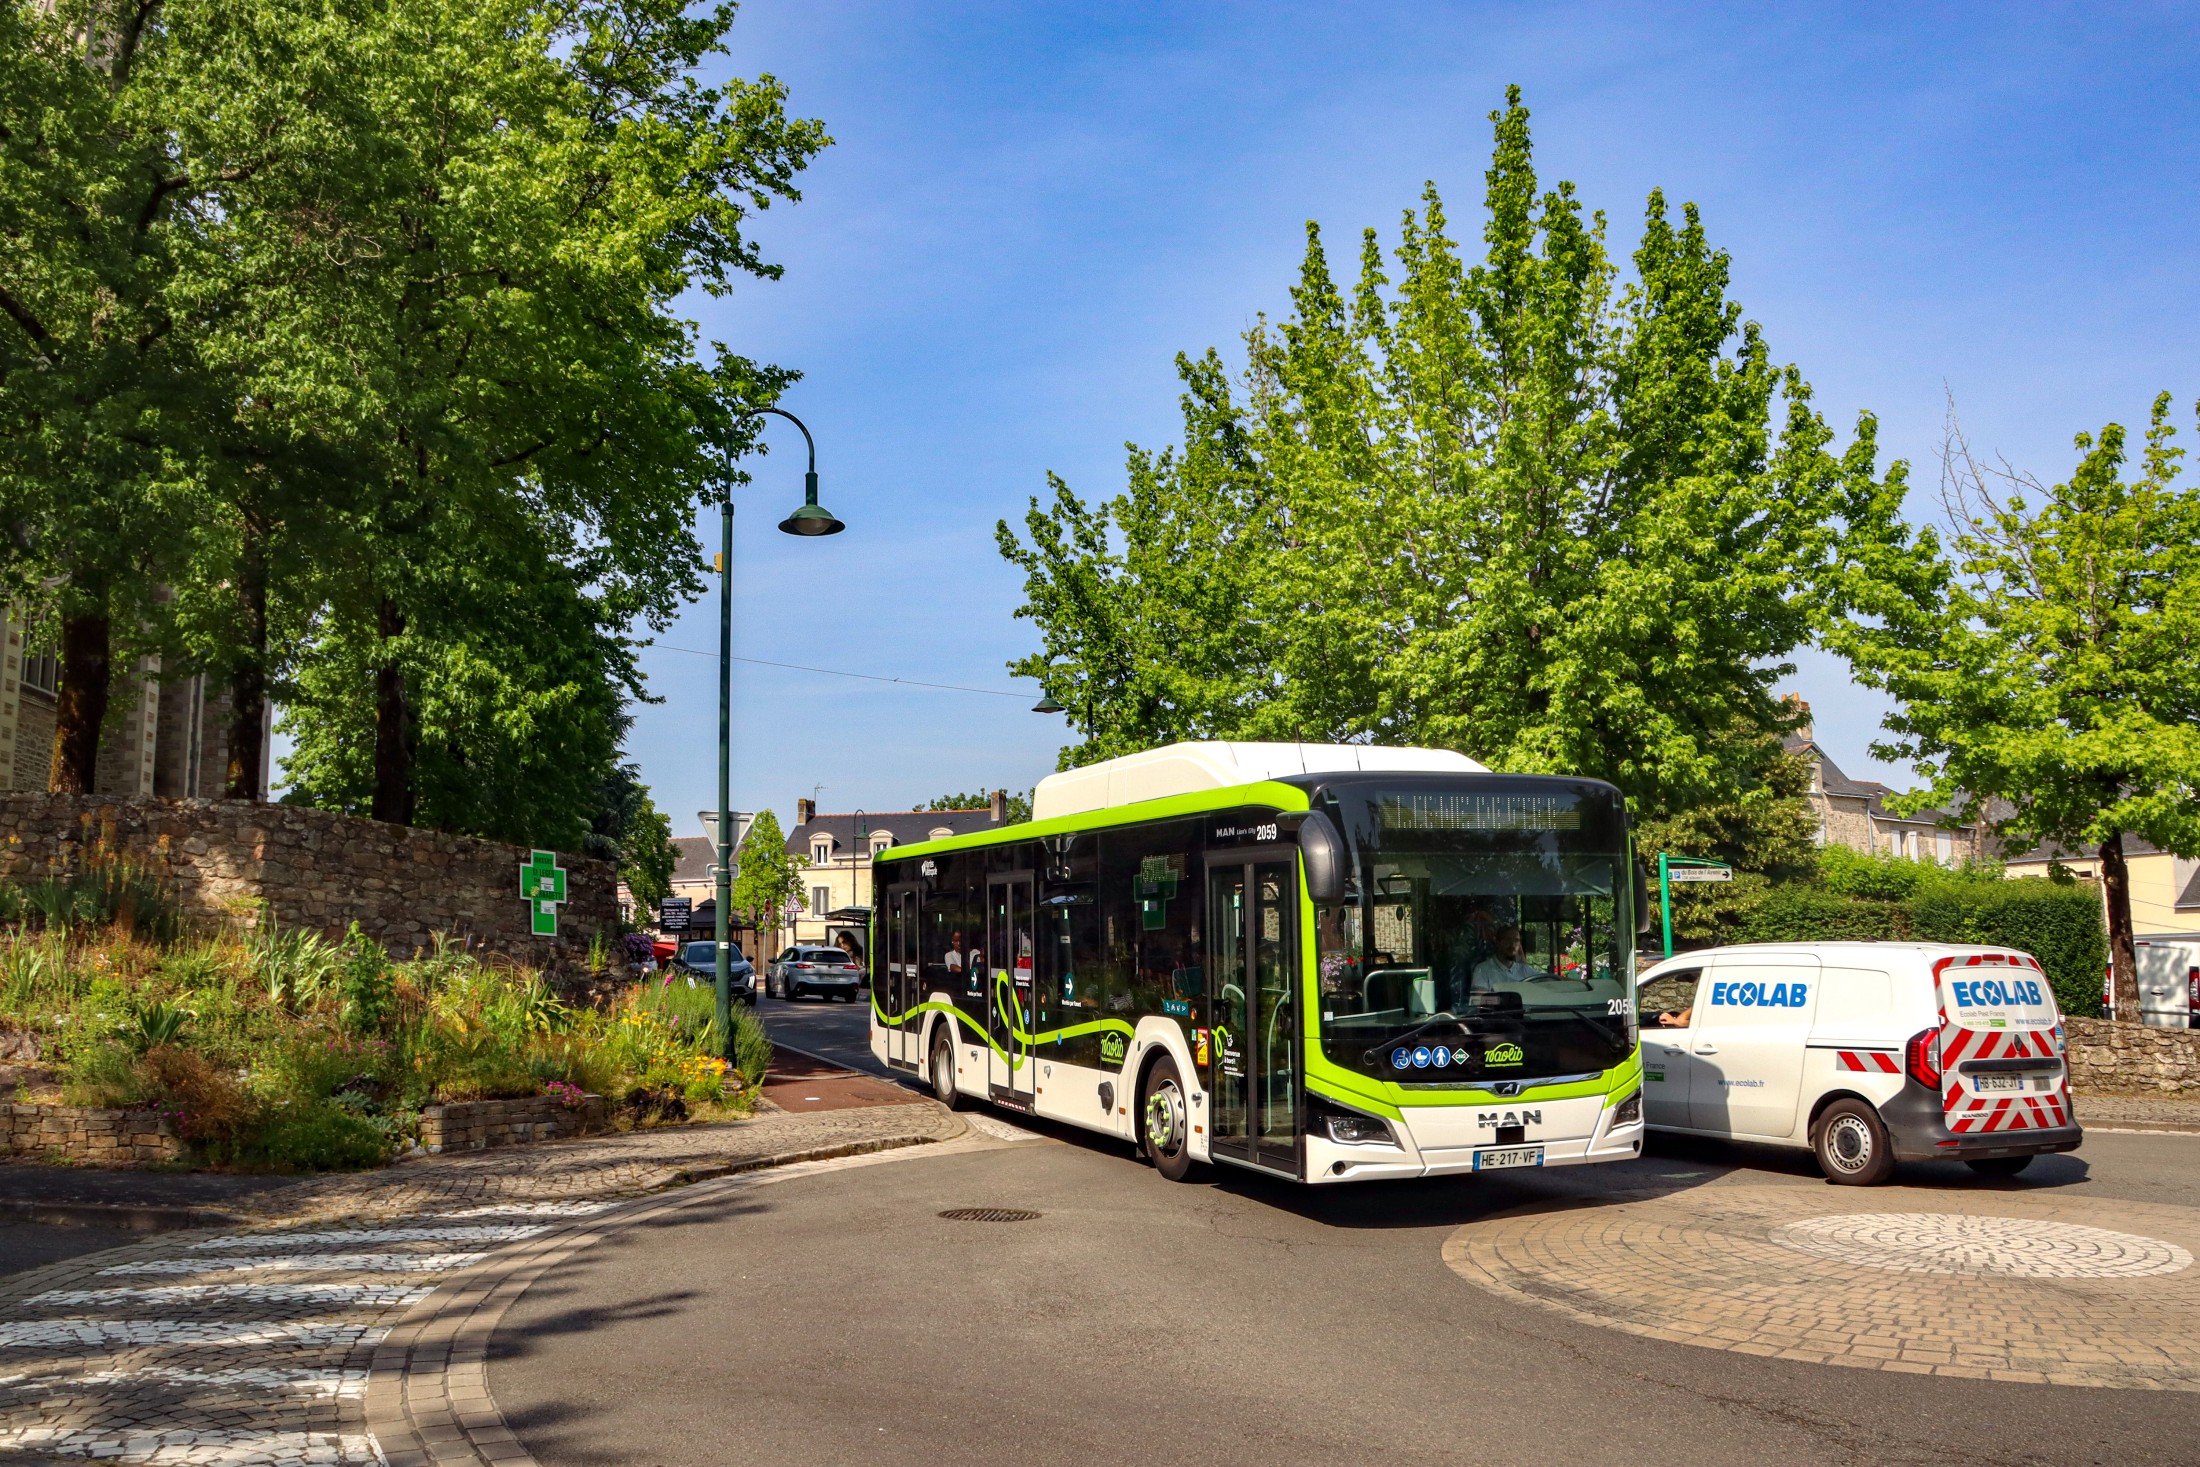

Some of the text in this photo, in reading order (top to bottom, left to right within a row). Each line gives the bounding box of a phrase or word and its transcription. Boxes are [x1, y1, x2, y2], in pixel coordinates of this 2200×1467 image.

[1216, 827, 1235, 838] MAN
[1256, 823, 1277, 841] 2059
[1711, 982, 1807, 1007] ECOLAB
[1952, 980, 2042, 1007] ECOLAB
[1607, 998, 1634, 1016] 2059
[1646, 1061, 1665, 1069] France
[1718, 1080, 1764, 1088] www.ecolab.fr
[1478, 1110, 1542, 1128] MAN
[1481, 1151, 1535, 1166] HE-217-VF
